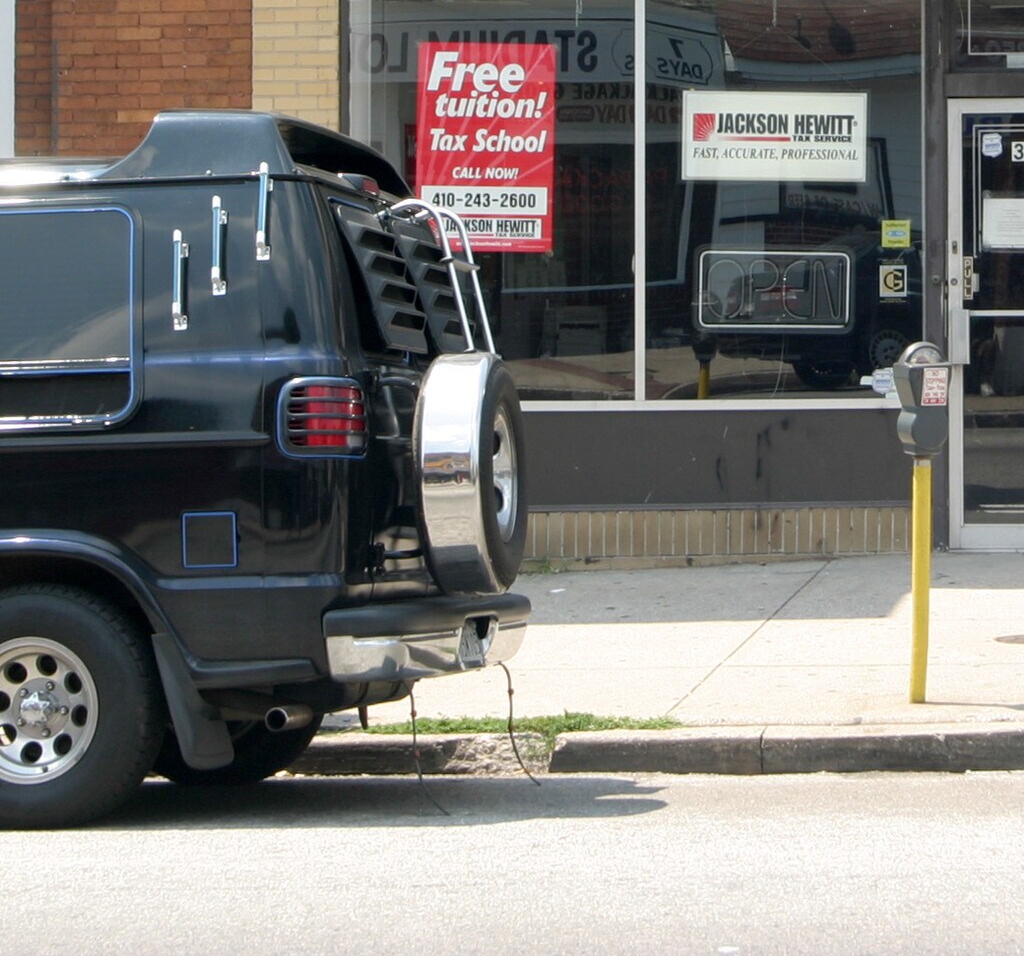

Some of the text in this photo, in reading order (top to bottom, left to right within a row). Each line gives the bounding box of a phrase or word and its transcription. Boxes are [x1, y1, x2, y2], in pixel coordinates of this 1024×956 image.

[427, 51, 525, 93] Free
[435, 90, 547, 119] tuition!
[717, 113, 855, 135] JACKSON HEWITT
[430, 128, 547, 153] Tax School
[792, 135, 853, 143] TAX SERVICE
[693, 147, 859, 161] FAST, ACCURATE, PROFESSIONAL
[452, 166, 519, 180] CALL NOW!
[432, 192, 536, 208] 410-243-2600
[496, 219, 537, 233] HEWITT
[707, 258, 843, 320] OPEN
[963, 258, 973, 299] PULL
